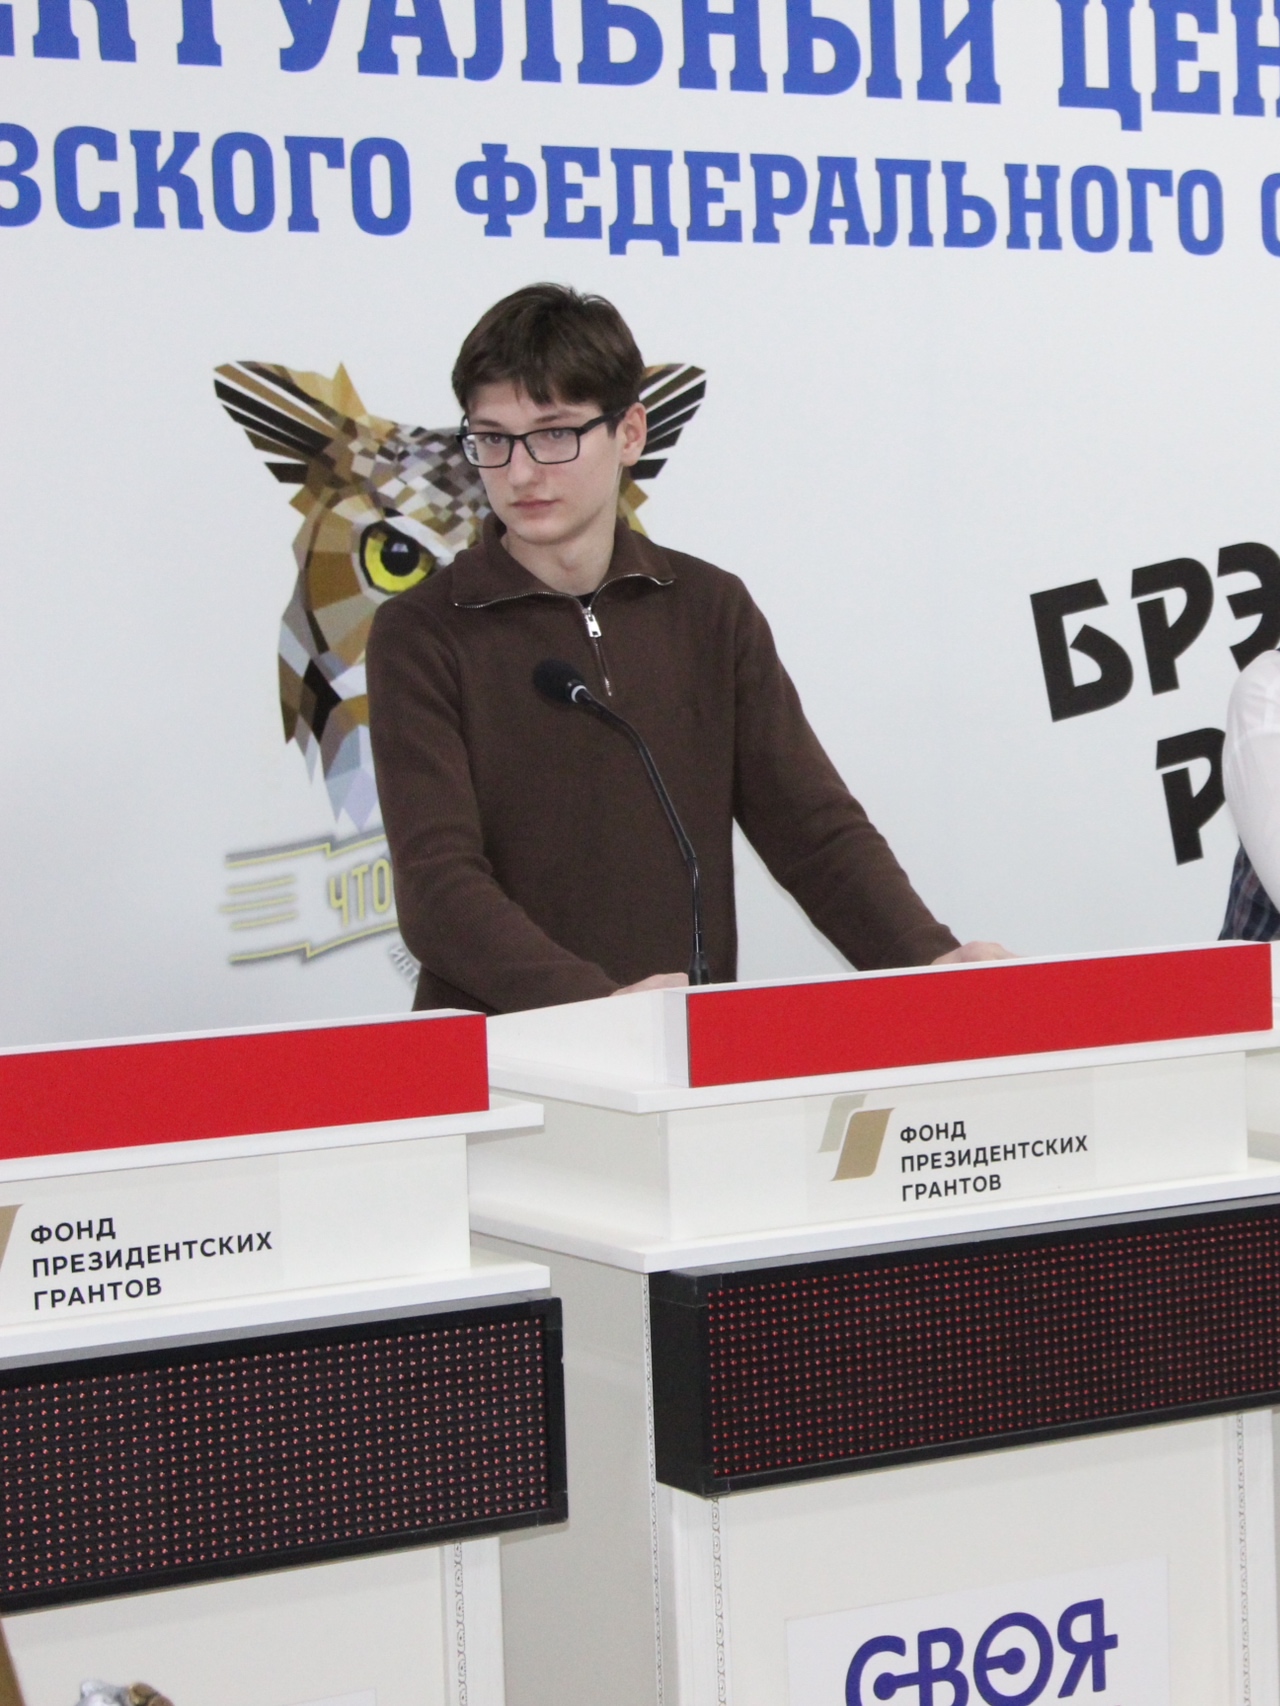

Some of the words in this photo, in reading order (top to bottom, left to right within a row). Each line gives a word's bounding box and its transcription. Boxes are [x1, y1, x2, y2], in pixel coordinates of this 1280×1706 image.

[455, 142, 1224, 257] ФЕДЕРАЛЬНОГО
[327, 857, 392, 927] ЧТО
[899, 1120, 967, 1144] ФОНД
[901, 1134, 1088, 1174] ПРЕЗИДЕНТСКИХ
[902, 1174, 1002, 1202] ГРАНТОВ
[30, 1217, 116, 1245] ФОНД
[32, 1231, 273, 1278] ПРЕЗИДЕНТСКИХ
[33, 1276, 162, 1311] ГРАНТОВ
[845, 1598, 1118, 1706] СВОЯ
